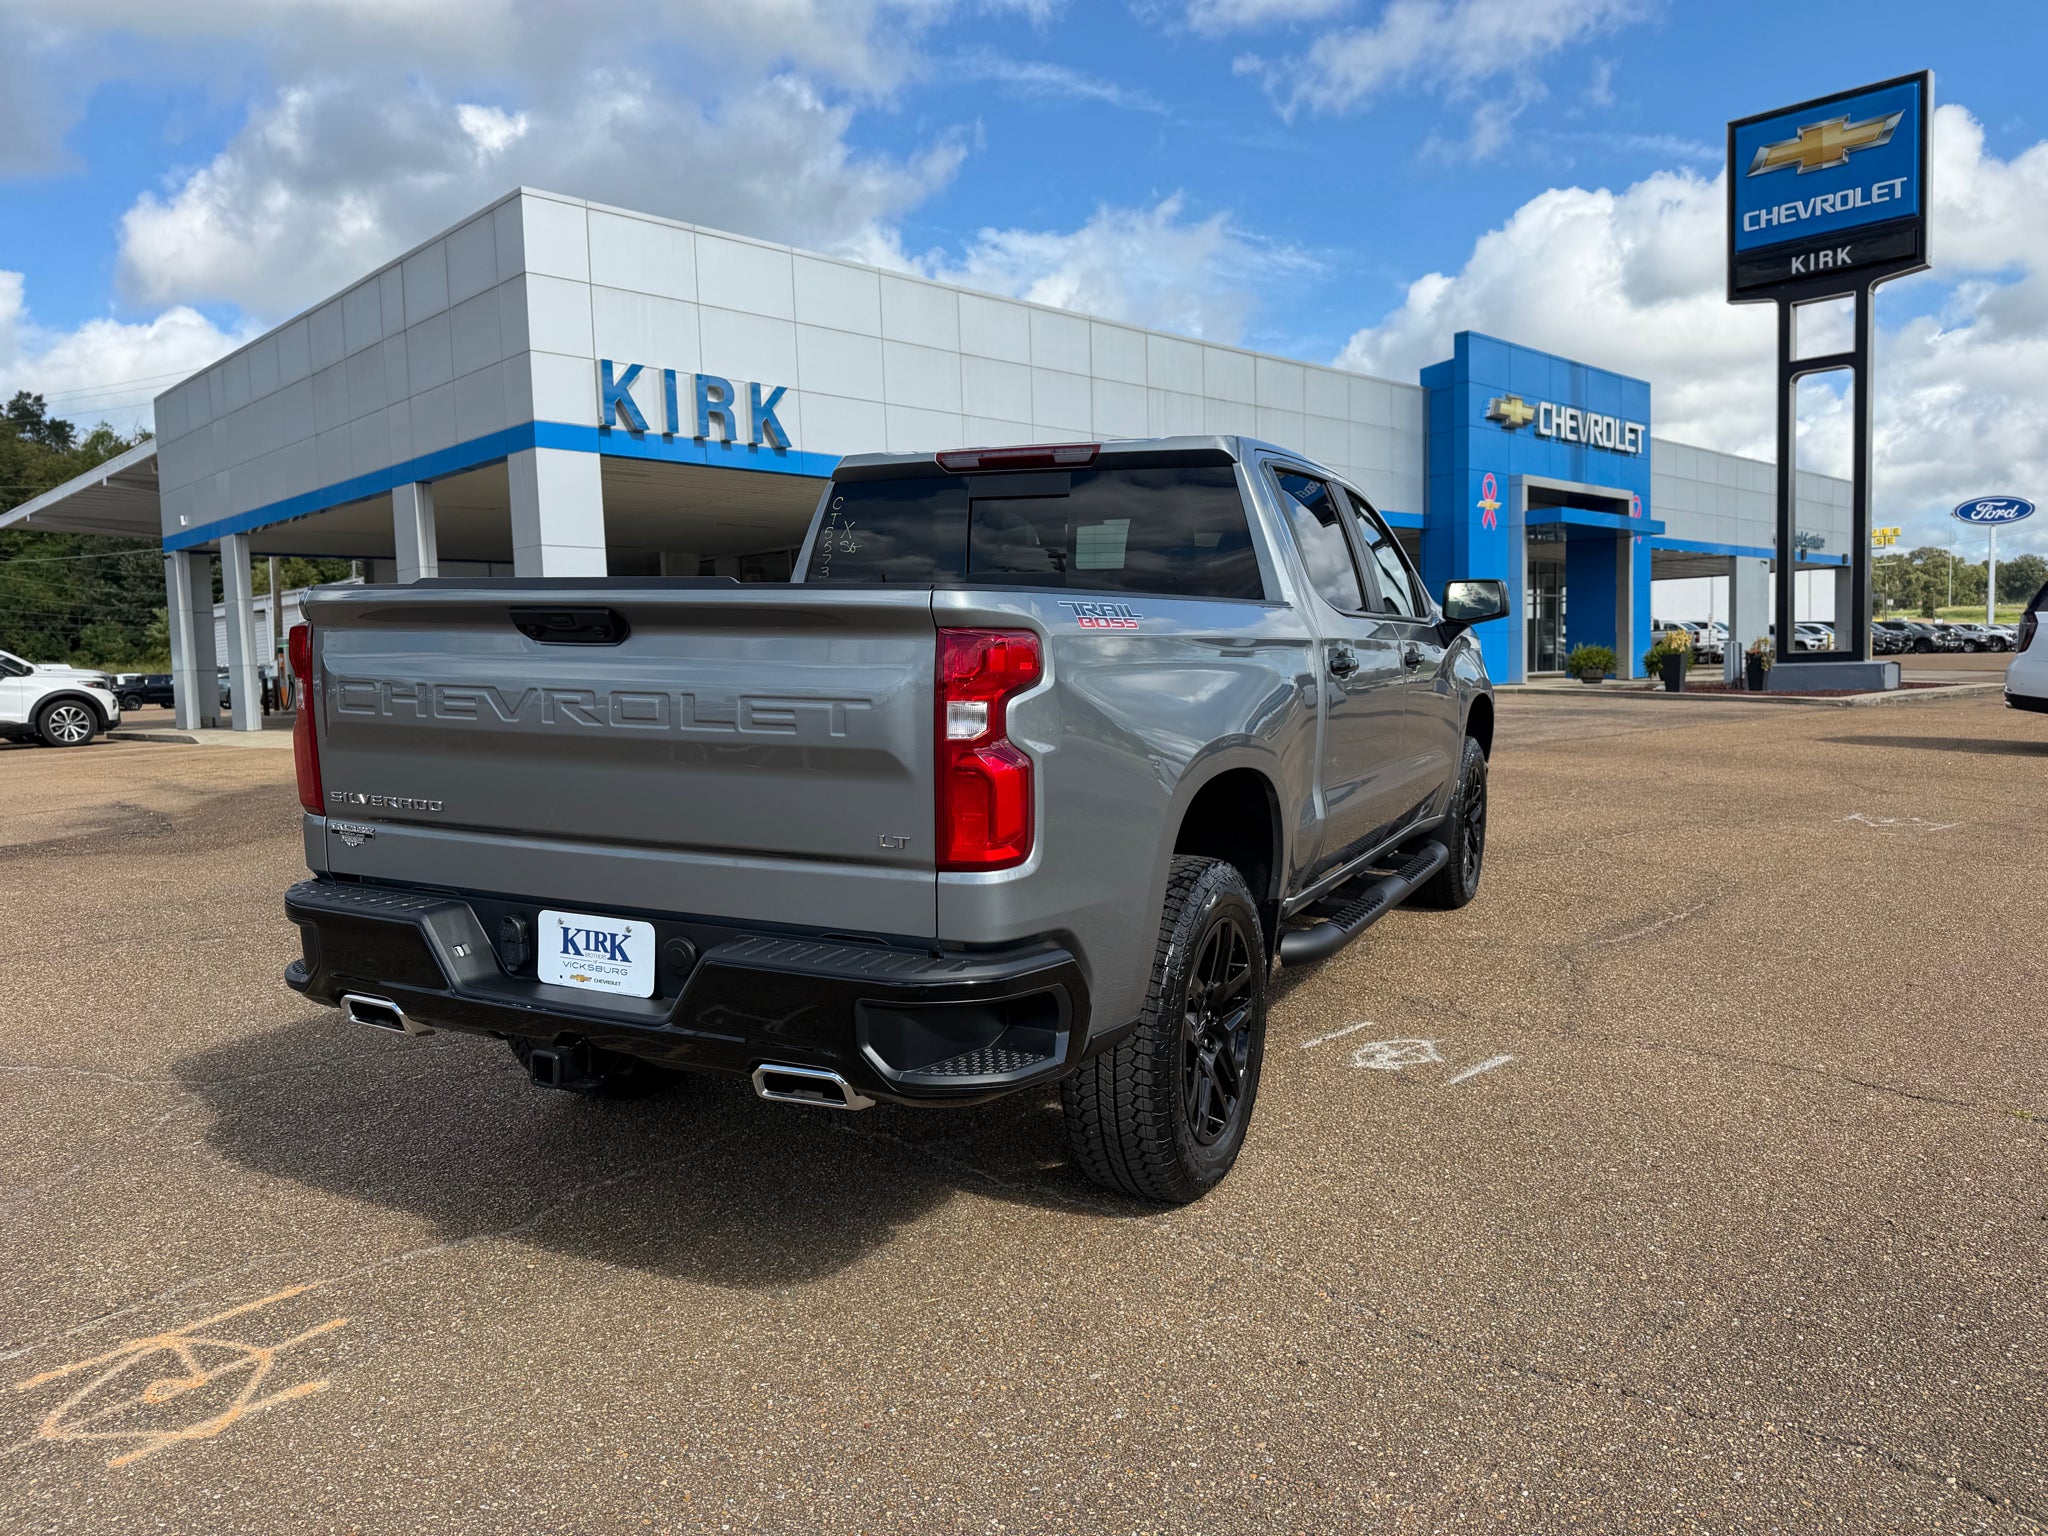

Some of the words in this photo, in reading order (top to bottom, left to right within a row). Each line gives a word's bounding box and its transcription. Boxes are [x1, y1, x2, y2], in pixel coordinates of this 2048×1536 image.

[1743, 176, 1908, 232] CHEVROLET
[1791, 245, 1853, 275] KIRK
[598, 359, 792, 448] KIRK
[1538, 401, 1645, 454] CHEVROLET
[1971, 501, 2020, 520] Ford
[1058, 601, 1144, 619] TRAIL
[1077, 616, 1139, 629] BOSS
[336, 680, 873, 738] CHEVROLET
[330, 791, 444, 812] SILVERADO
[879, 834, 911, 849] LT
[560, 926, 632, 963] KIRK
[593, 978, 621, 987] CHEVROLET
